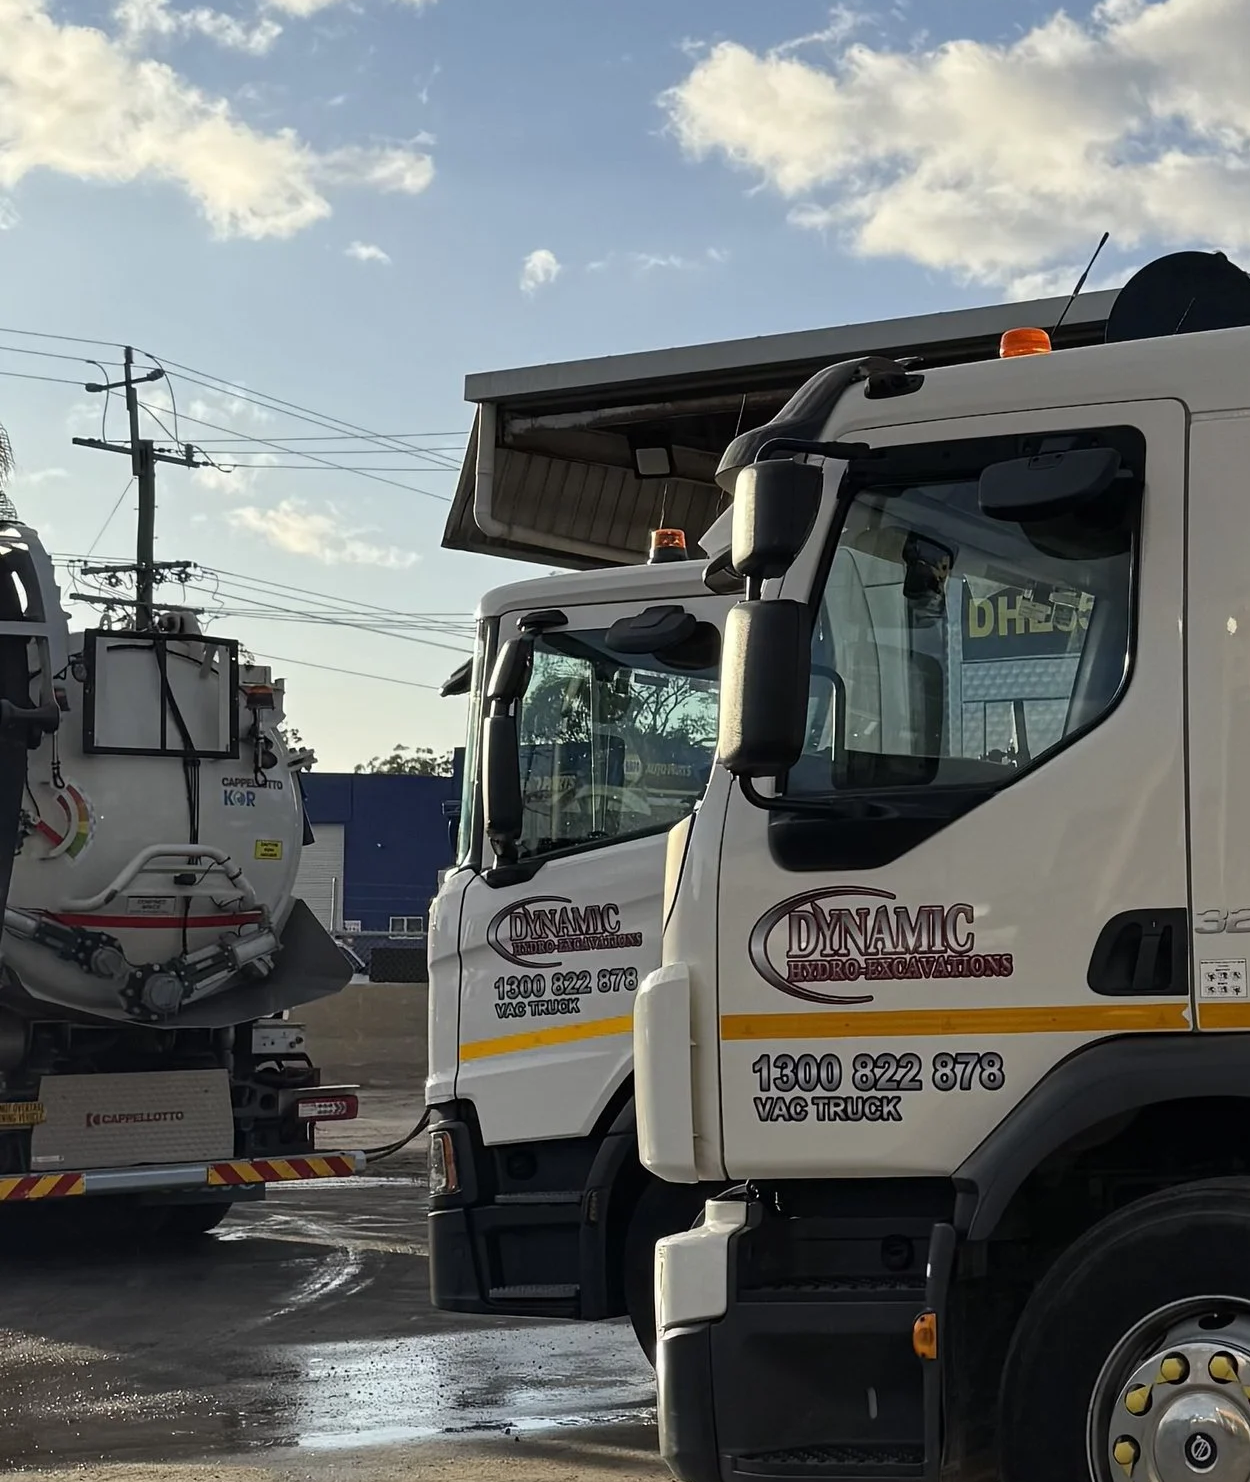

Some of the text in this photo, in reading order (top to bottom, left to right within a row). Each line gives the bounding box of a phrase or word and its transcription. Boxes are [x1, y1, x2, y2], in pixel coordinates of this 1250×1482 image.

[509, 903, 621, 941] DYNAMIC
[786, 902, 975, 958] DYNAMIC
[512, 932, 643, 955] HYDRO-EXCAVATIONS
[494, 967, 638, 1000] 1300 822 878
[786, 953, 1014, 984] HYDRO-EXCAVATIONS
[495, 997, 580, 1018] VAC TRUCK
[752, 1051, 1005, 1092] 1300 822 878
[102, 1111, 184, 1124] CAPPELLOTTO
[753, 1095, 903, 1122] VAC TRUCK
